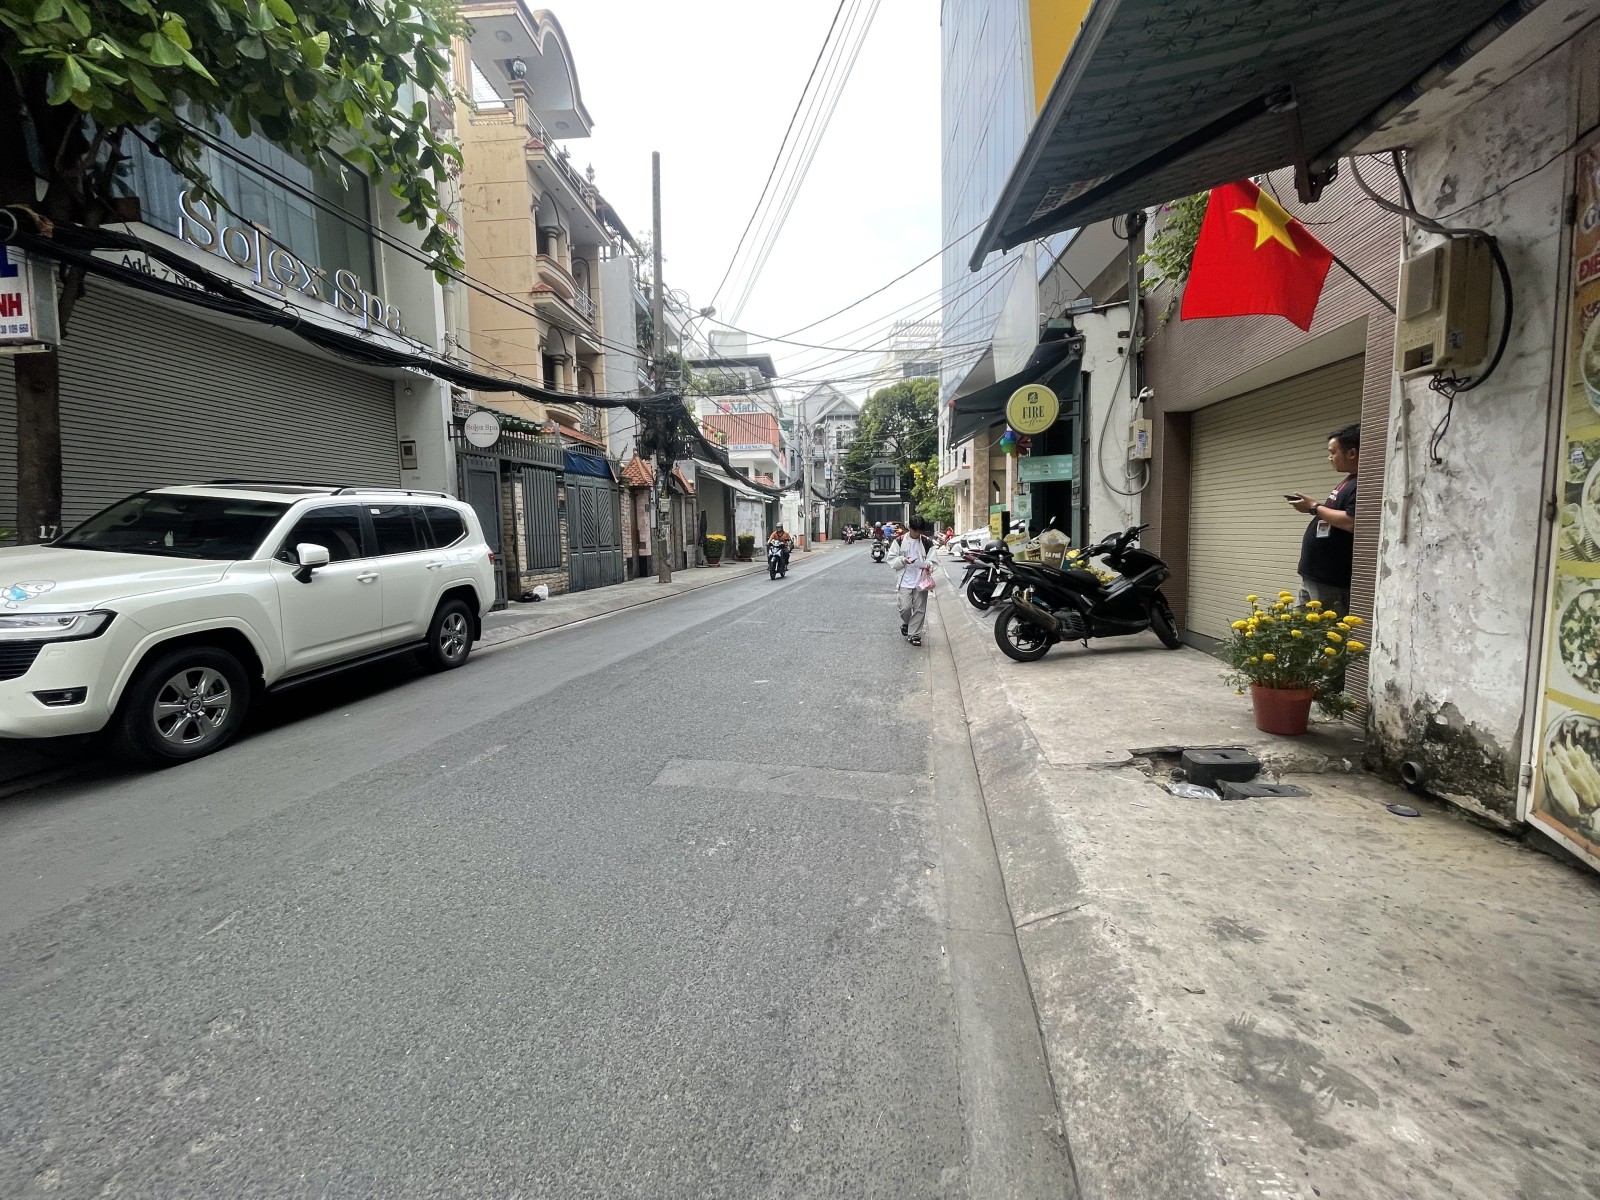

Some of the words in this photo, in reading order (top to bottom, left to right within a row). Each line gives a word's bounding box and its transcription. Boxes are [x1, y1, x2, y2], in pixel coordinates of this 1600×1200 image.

[121, 254, 156, 276] Add:
[179, 190, 328, 300] Solex
[334, 269, 406, 334] Spa
[39, 525, 58, 539] 17
